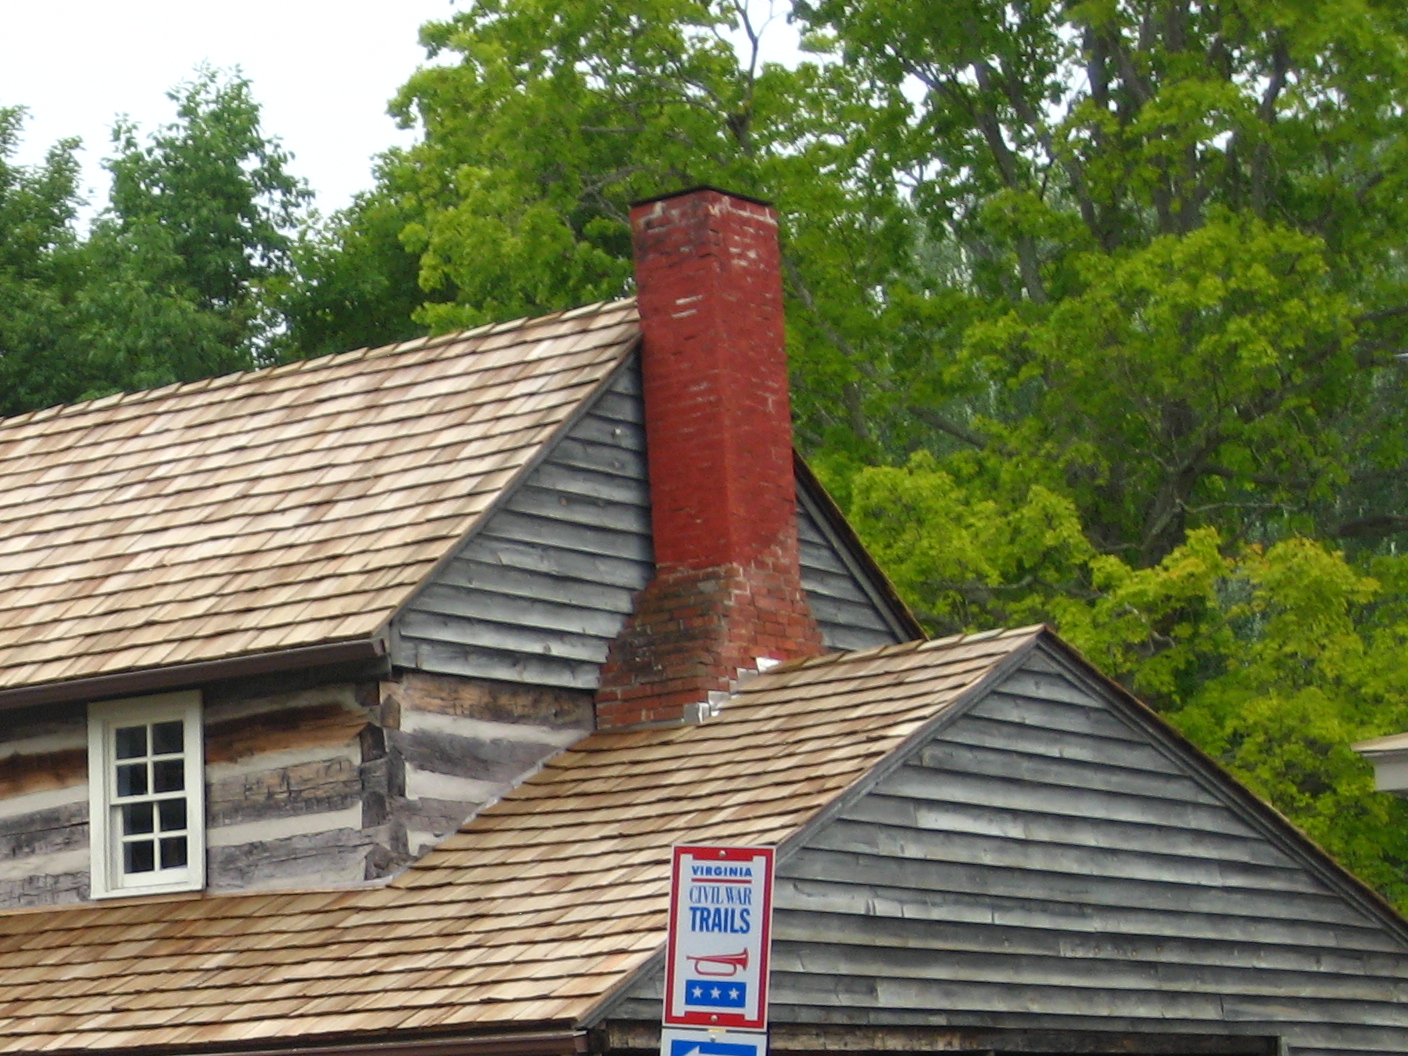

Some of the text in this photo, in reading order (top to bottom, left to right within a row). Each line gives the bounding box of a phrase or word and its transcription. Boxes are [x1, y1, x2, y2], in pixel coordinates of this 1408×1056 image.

[691, 865, 753, 877] VIRGINIA
[689, 885, 752, 905] CIVIL WAR
[689, 906, 751, 934] TRAILS
